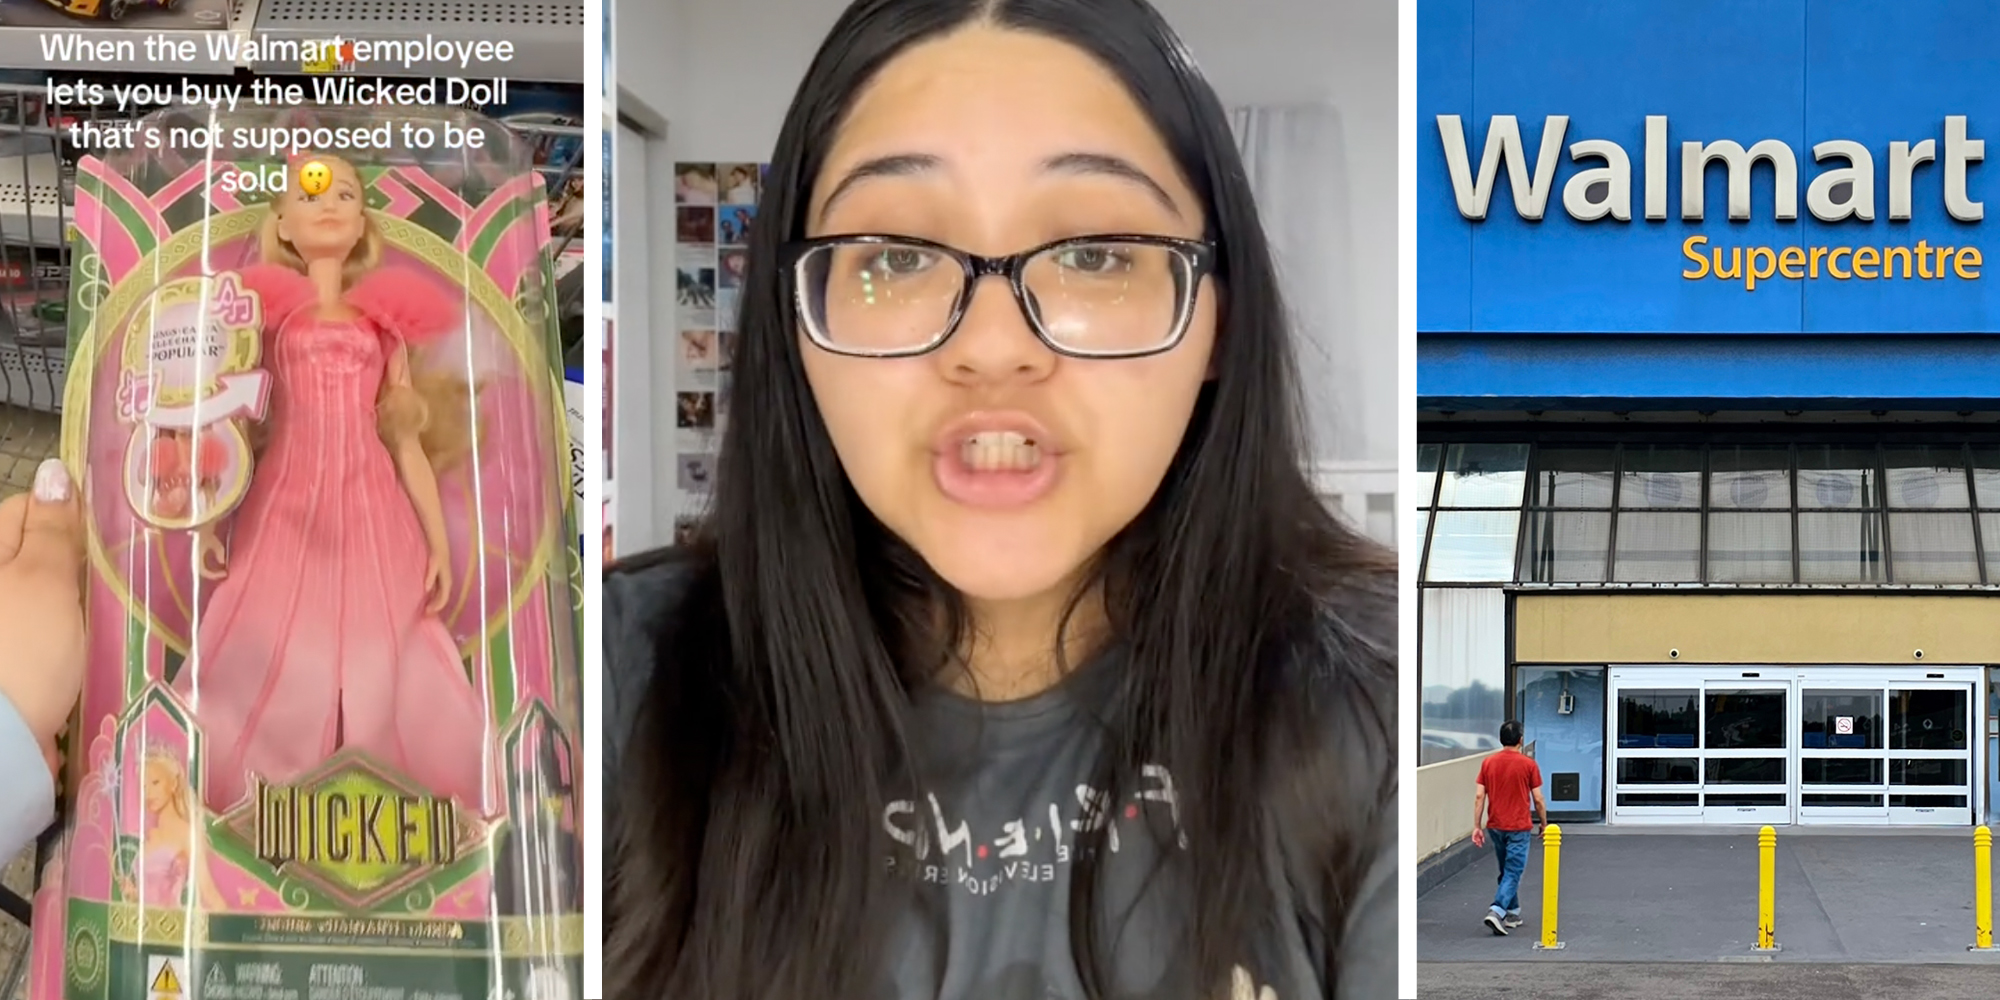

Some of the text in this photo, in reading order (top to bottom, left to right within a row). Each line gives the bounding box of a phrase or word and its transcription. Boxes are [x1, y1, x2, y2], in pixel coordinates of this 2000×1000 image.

[1436, 114, 1985, 221] Walmart
[1682, 235, 1984, 290] Supercentre
[255, 776, 457, 874] WICKED
